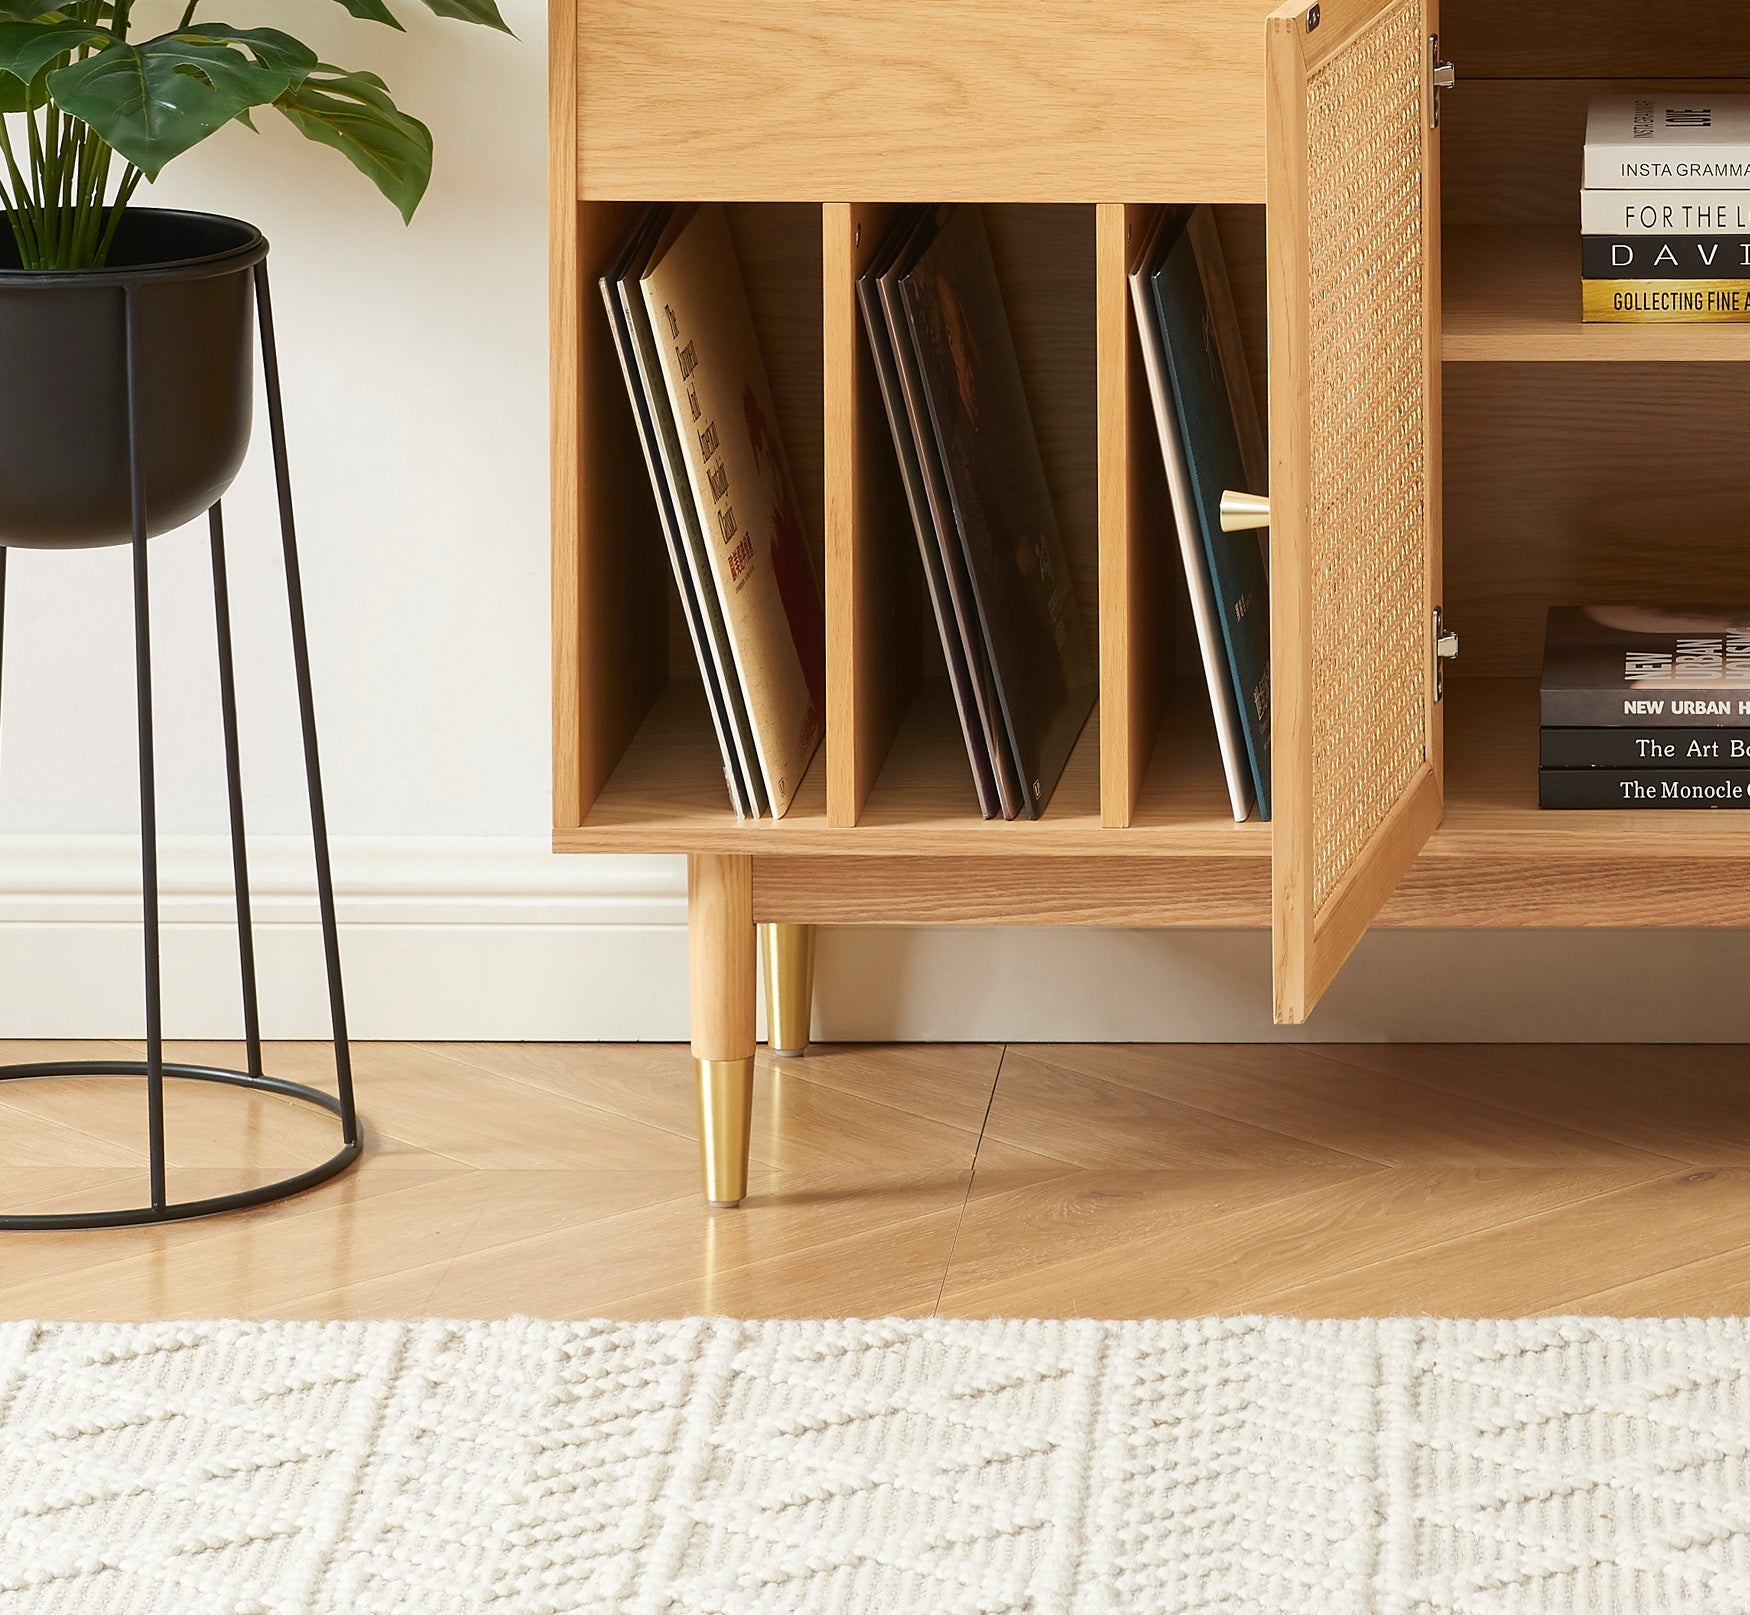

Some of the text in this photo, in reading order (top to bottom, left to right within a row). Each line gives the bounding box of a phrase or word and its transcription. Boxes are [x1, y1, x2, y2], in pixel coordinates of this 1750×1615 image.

[1665, 109, 1711, 127] LOVE
[1621, 163, 1673, 177] INSTA
[1625, 205, 1674, 229] FOR
[1681, 205, 1727, 228] THE
[1613, 291, 1704, 312] GOLLECTING
[1707, 291, 1740, 311] FINE
[1625, 651, 1673, 681] NEW
[1676, 639, 1723, 680] URBAN
[1624, 700, 1665, 715] NEW
[1671, 700, 1731, 715] URBAN
[1635, 739, 1675, 758] The
[1686, 739, 1719, 757] Art
[1619, 780, 1657, 799] The
[1660, 780, 1743, 799] Monocle
